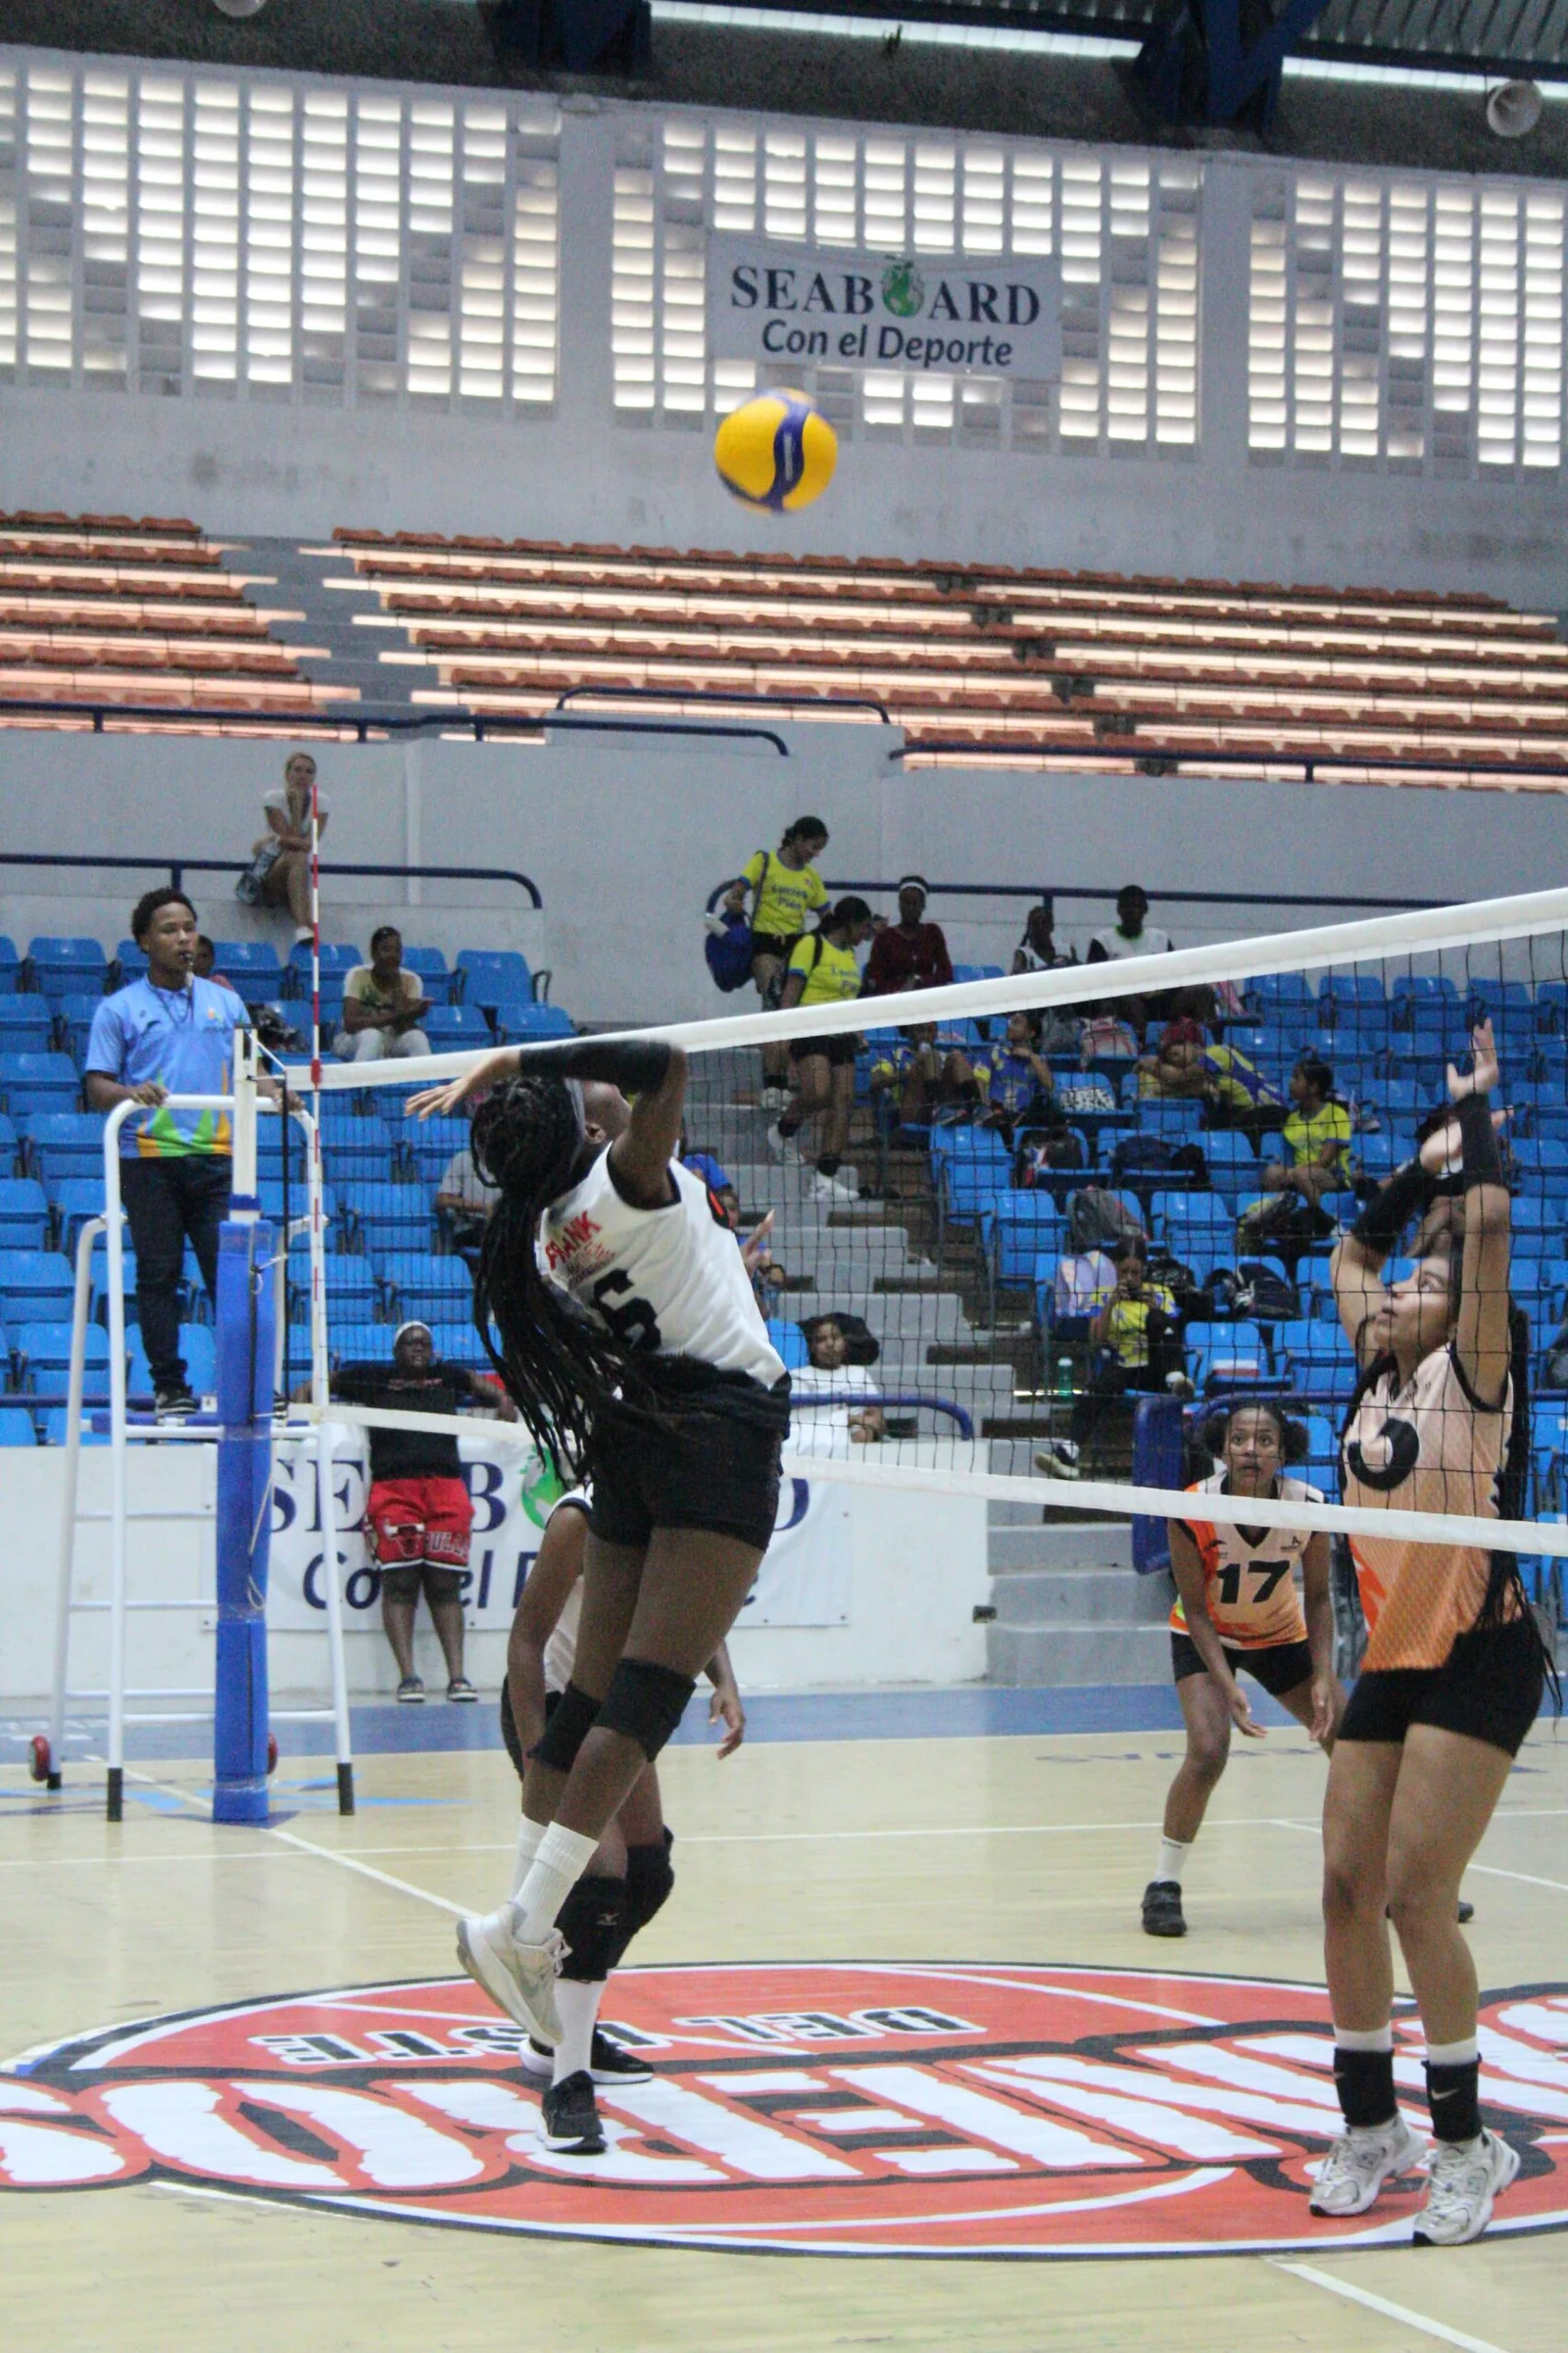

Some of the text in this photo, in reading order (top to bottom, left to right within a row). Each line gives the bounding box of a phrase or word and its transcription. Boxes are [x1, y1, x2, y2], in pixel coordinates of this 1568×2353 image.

[761, 319, 1012, 368] Con el Deporte
[1216, 1560, 1291, 1603] 17
[674, 2007, 985, 2042] DEL
